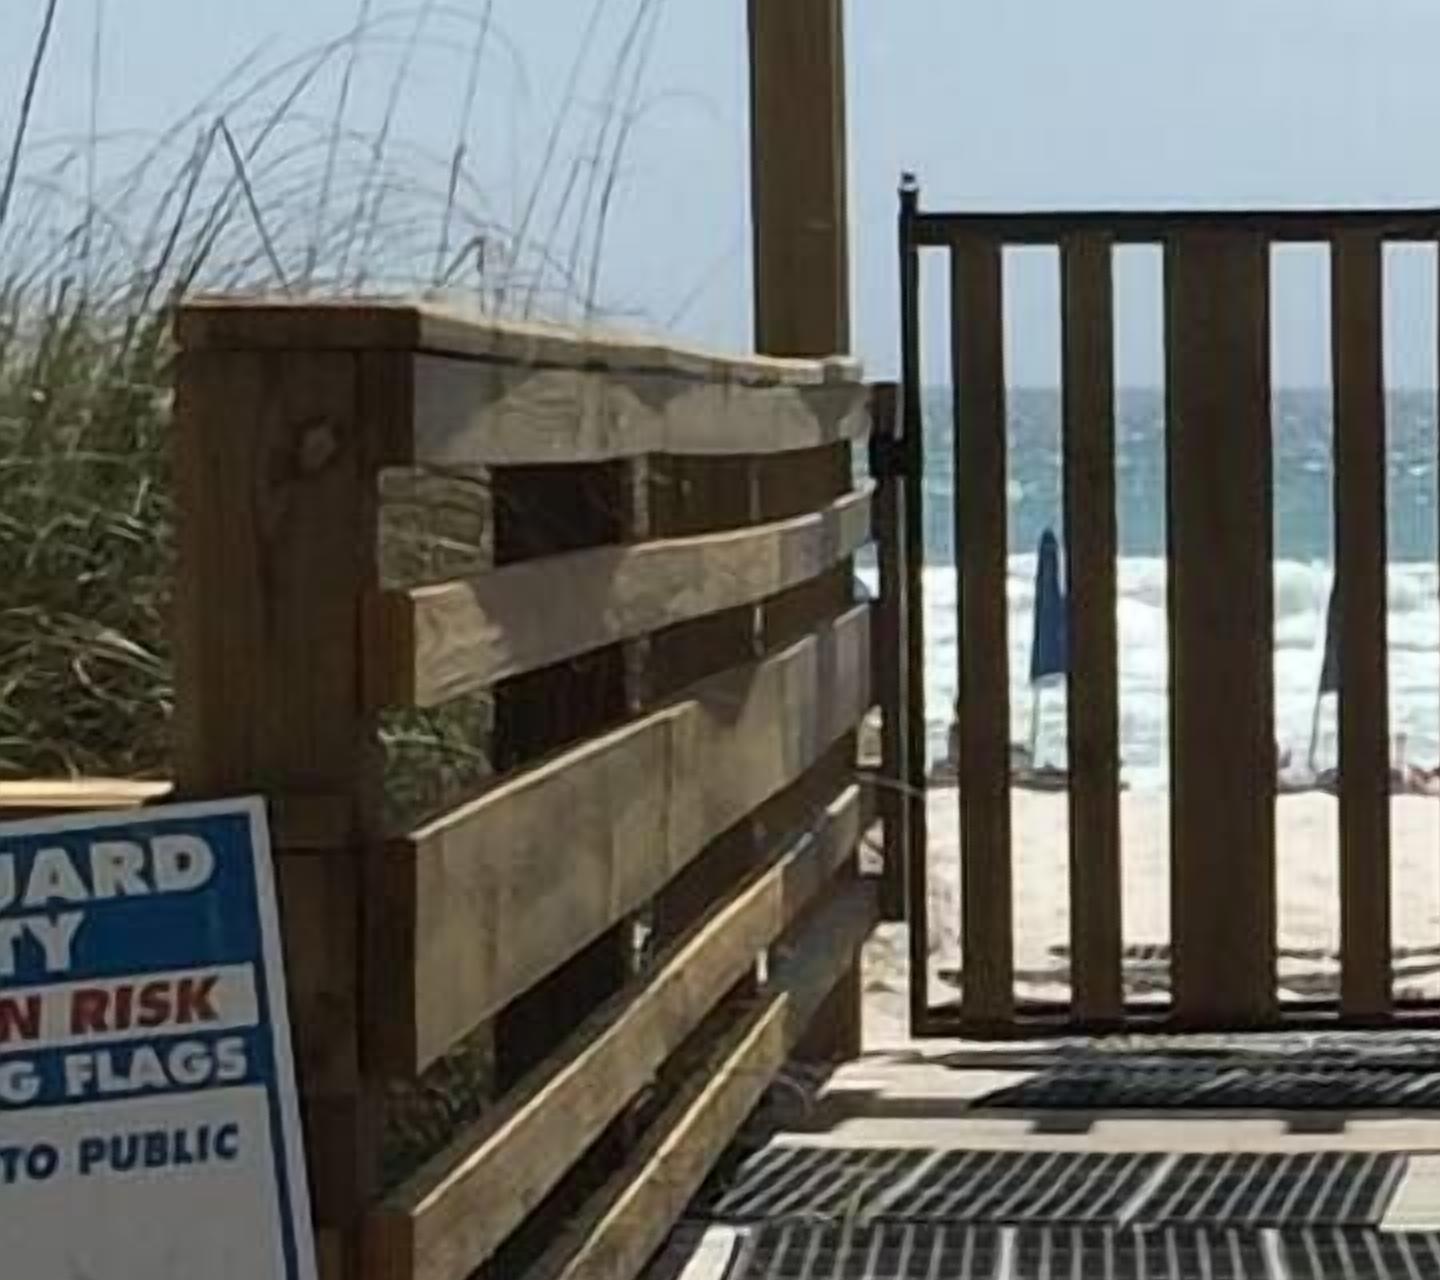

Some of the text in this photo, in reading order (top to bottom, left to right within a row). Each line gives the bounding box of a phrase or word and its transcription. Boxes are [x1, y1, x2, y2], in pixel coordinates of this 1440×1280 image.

[70, 975, 219, 1036] RISK
[64, 1035, 248, 1097] FLAGS
[78, 1123, 239, 1175] PUBLIC
